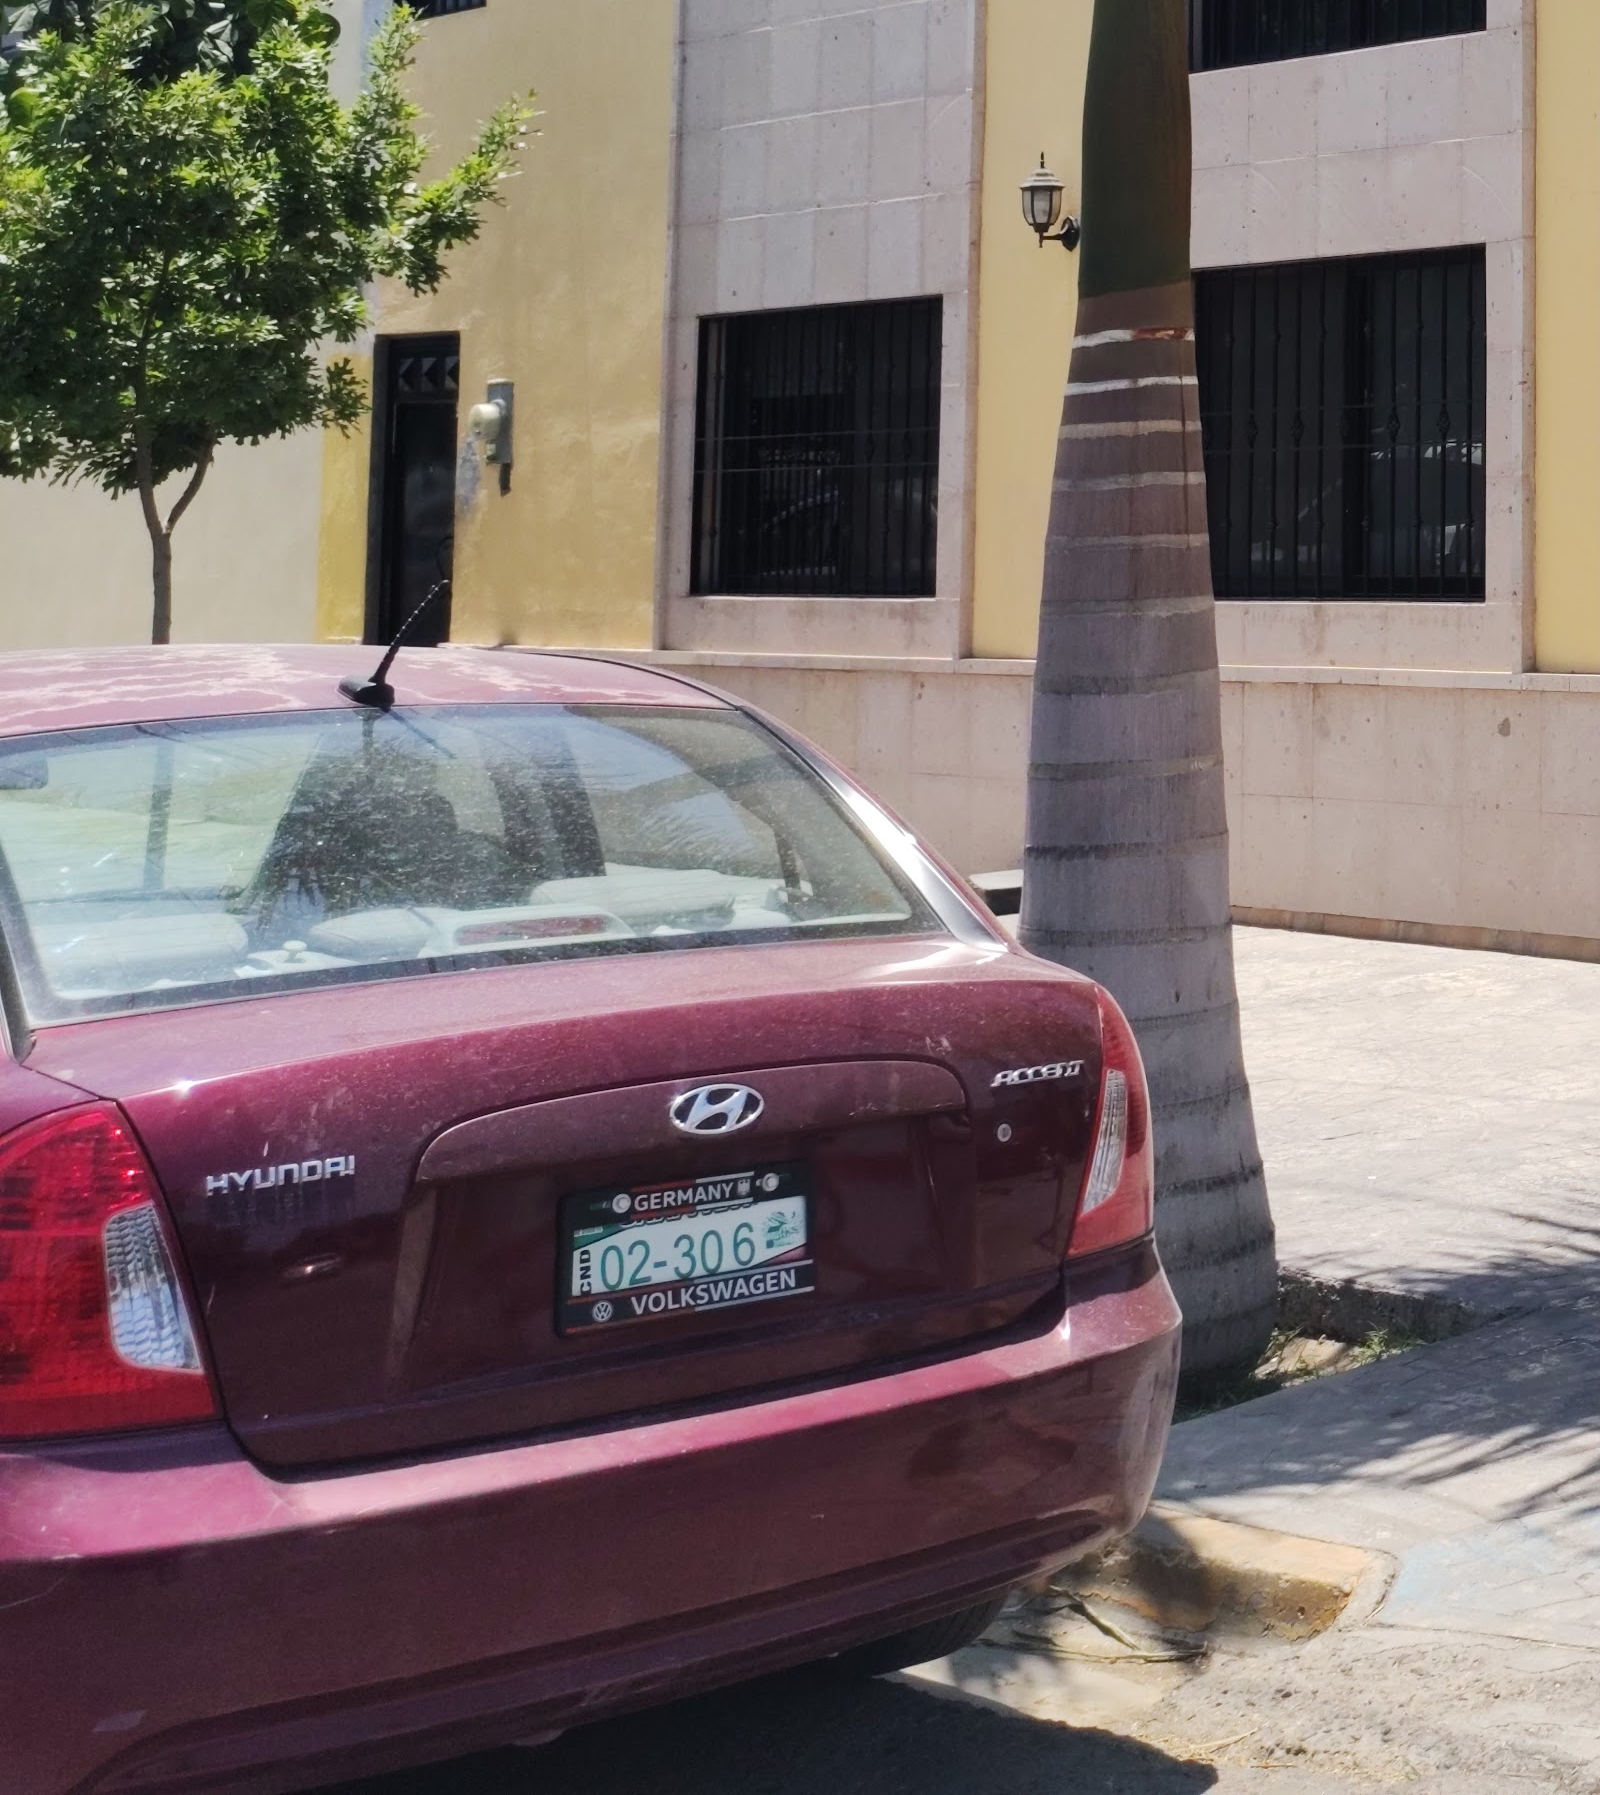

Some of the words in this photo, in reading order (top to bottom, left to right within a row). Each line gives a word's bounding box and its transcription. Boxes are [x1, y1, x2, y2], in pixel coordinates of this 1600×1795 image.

[990, 1059, 1085, 1087] ACCENT
[206, 1154, 356, 1196] HYUNDAI
[633, 1181, 734, 1212] GERMANY
[630, 1268, 797, 1315] VOLKSWAGEN
